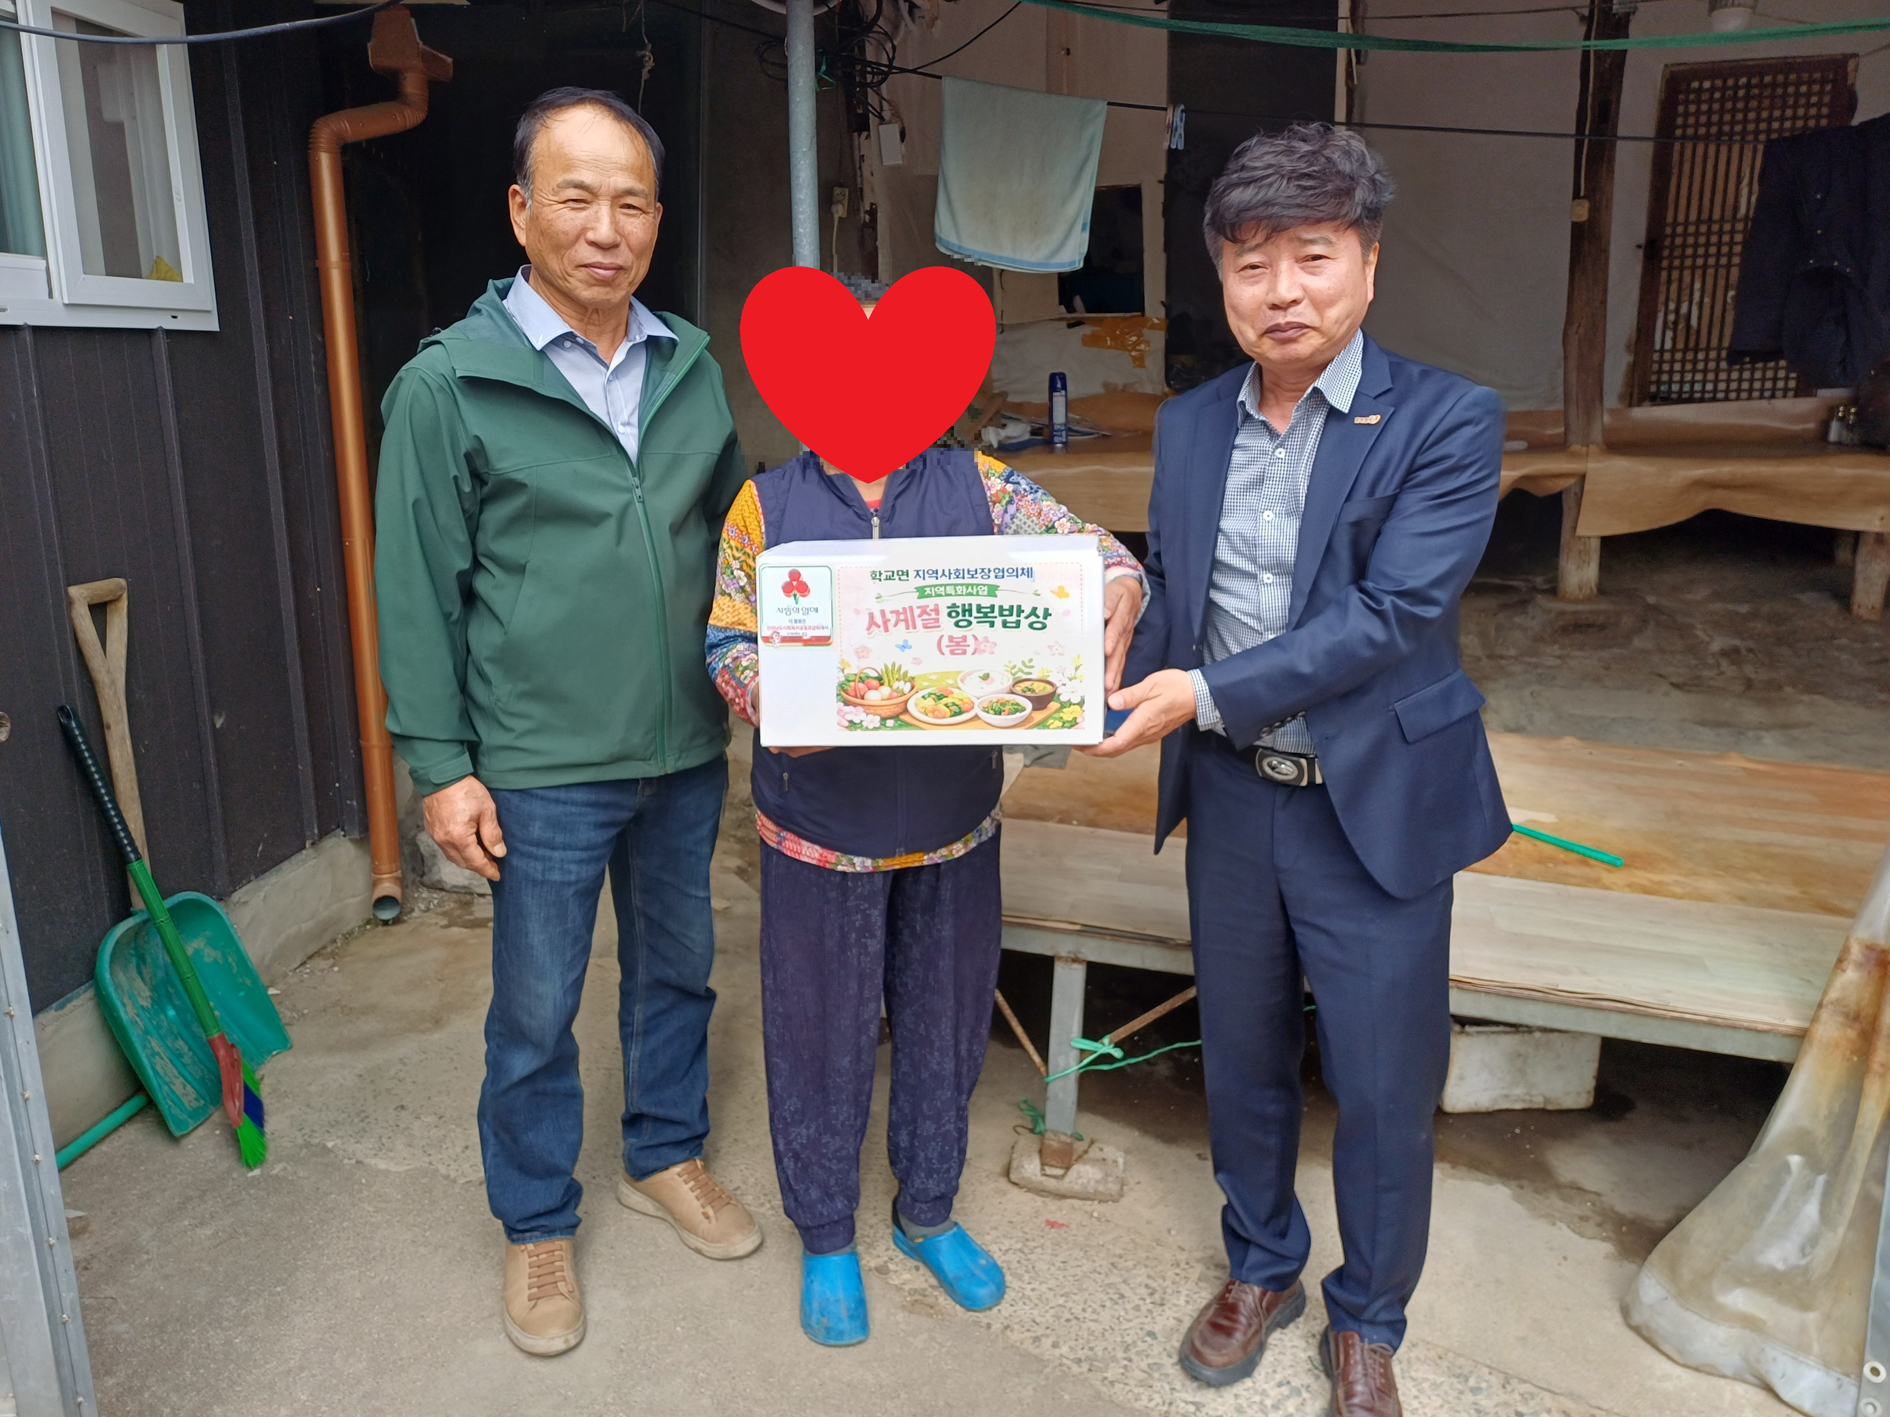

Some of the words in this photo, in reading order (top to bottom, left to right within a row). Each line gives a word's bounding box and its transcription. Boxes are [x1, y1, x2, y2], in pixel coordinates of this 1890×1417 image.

[870, 569, 910, 582] 학교면
[913, 567, 1033, 581] 지역사회보장협의체
[924, 585, 988, 596] 지역특화사업
[865, 603, 942, 634] 사계절
[946, 602, 1052, 631] 행복밥상
[936, 634, 979, 656] (봄)
